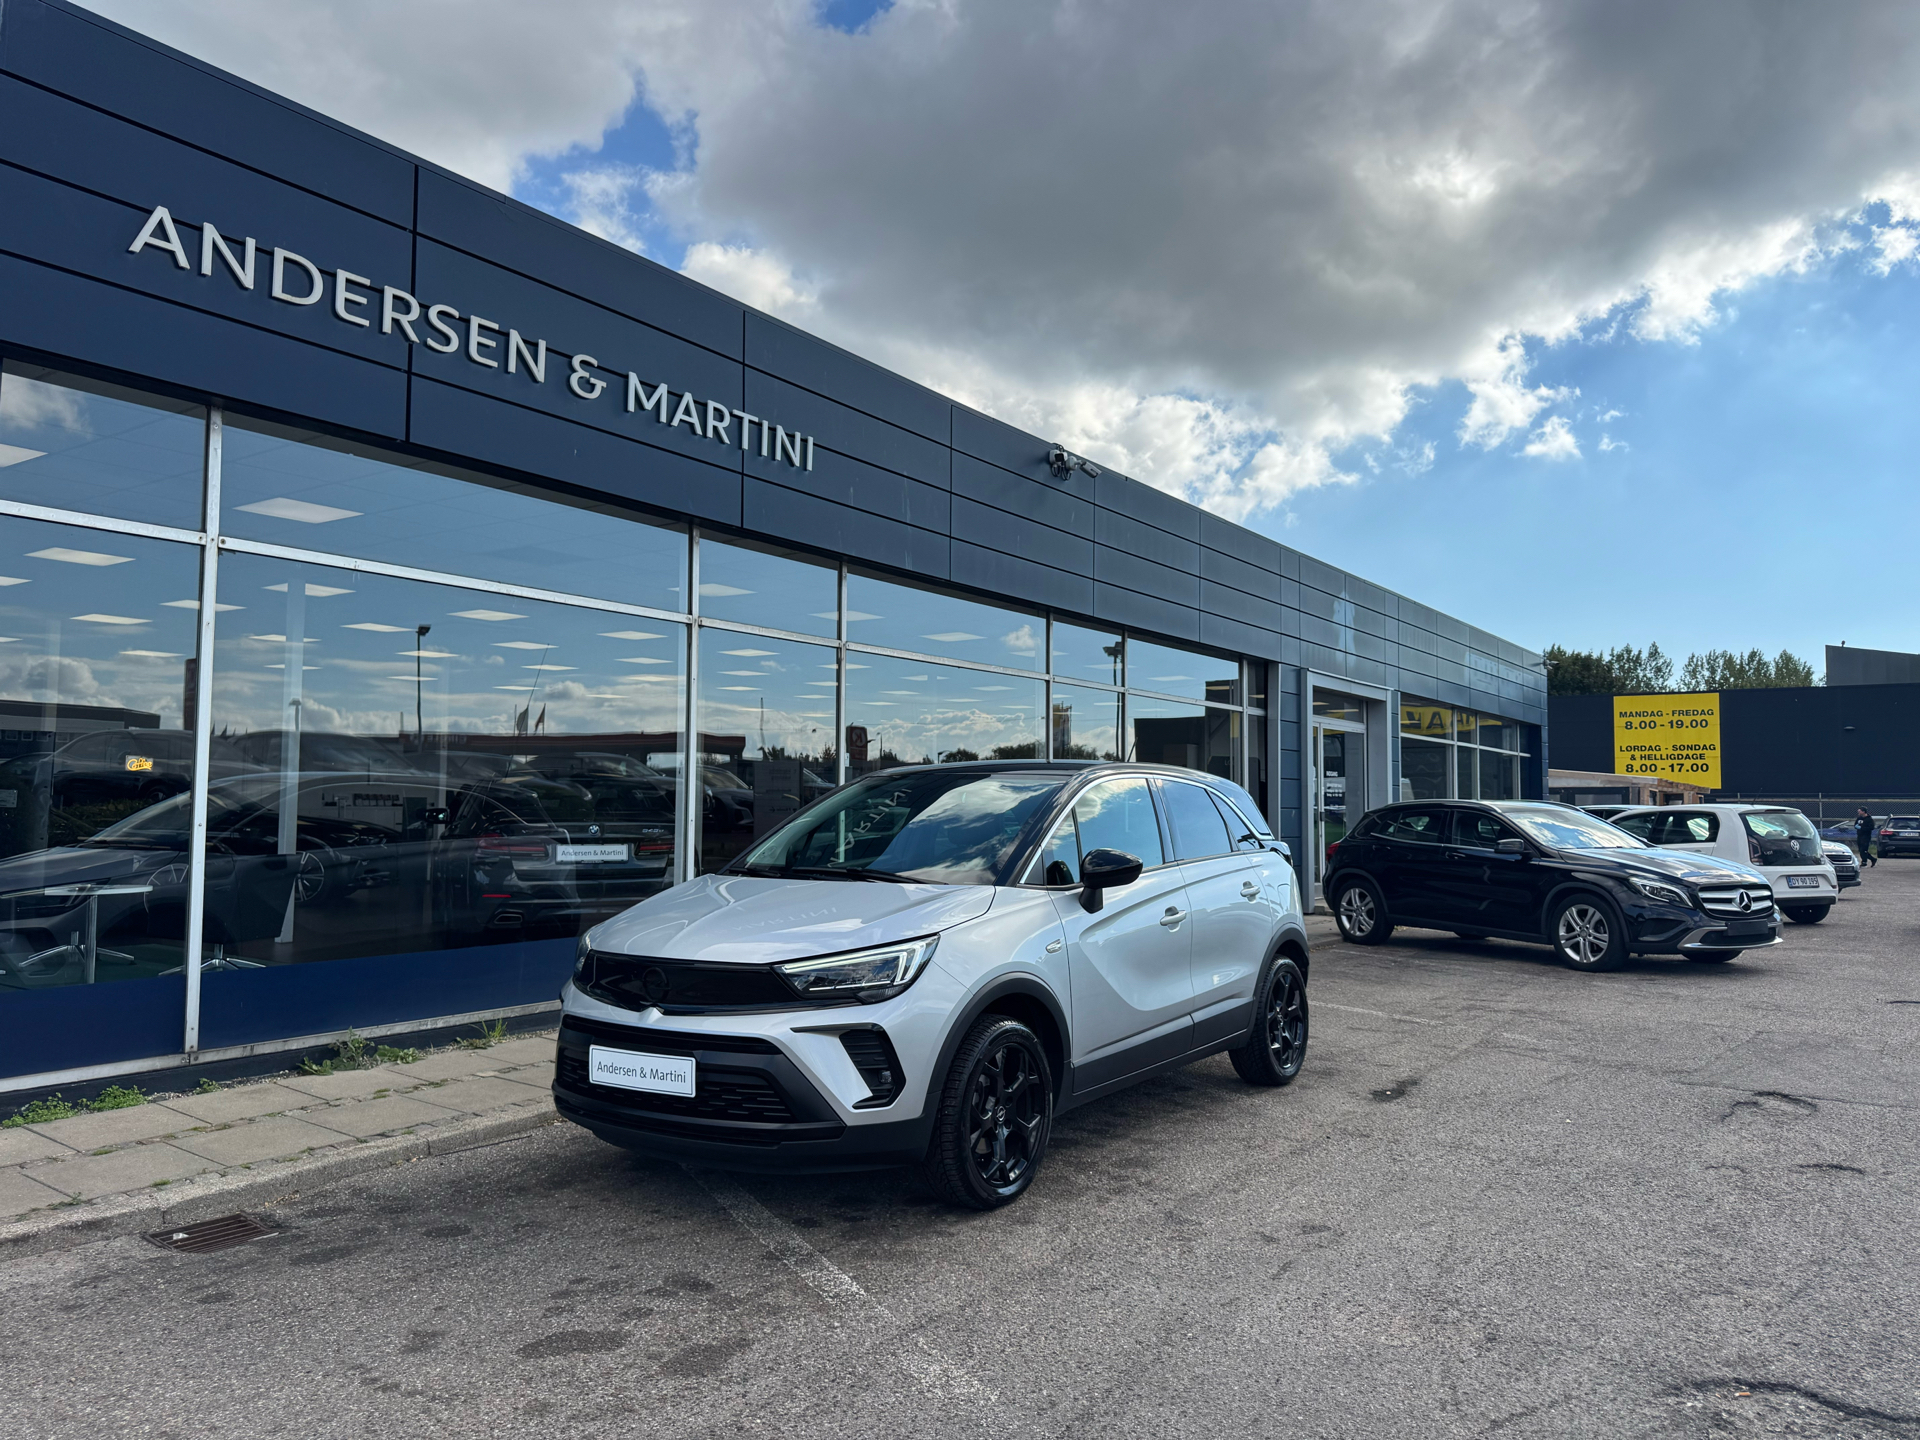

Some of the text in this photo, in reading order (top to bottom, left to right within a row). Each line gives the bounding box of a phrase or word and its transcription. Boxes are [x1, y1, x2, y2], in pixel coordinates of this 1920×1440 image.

[128, 206, 815, 471] ANDERSEN & MARTINI
[1619, 710, 1664, 718] MANDAG
[1672, 709, 1714, 717] FREDAG
[1624, 720, 1657, 730] 8.00
[1668, 719, 1709, 729] 19.00
[1620, 744, 1662, 752] LØRDAG
[1672, 743, 1716, 751] SØNDAG
[1640, 753, 1706, 761] HELLIGDAGE
[1625, 763, 1657, 773] 8.00
[1668, 763, 1709, 772] 17.00
[596, 1061, 686, 1083] Andersen & Martini
